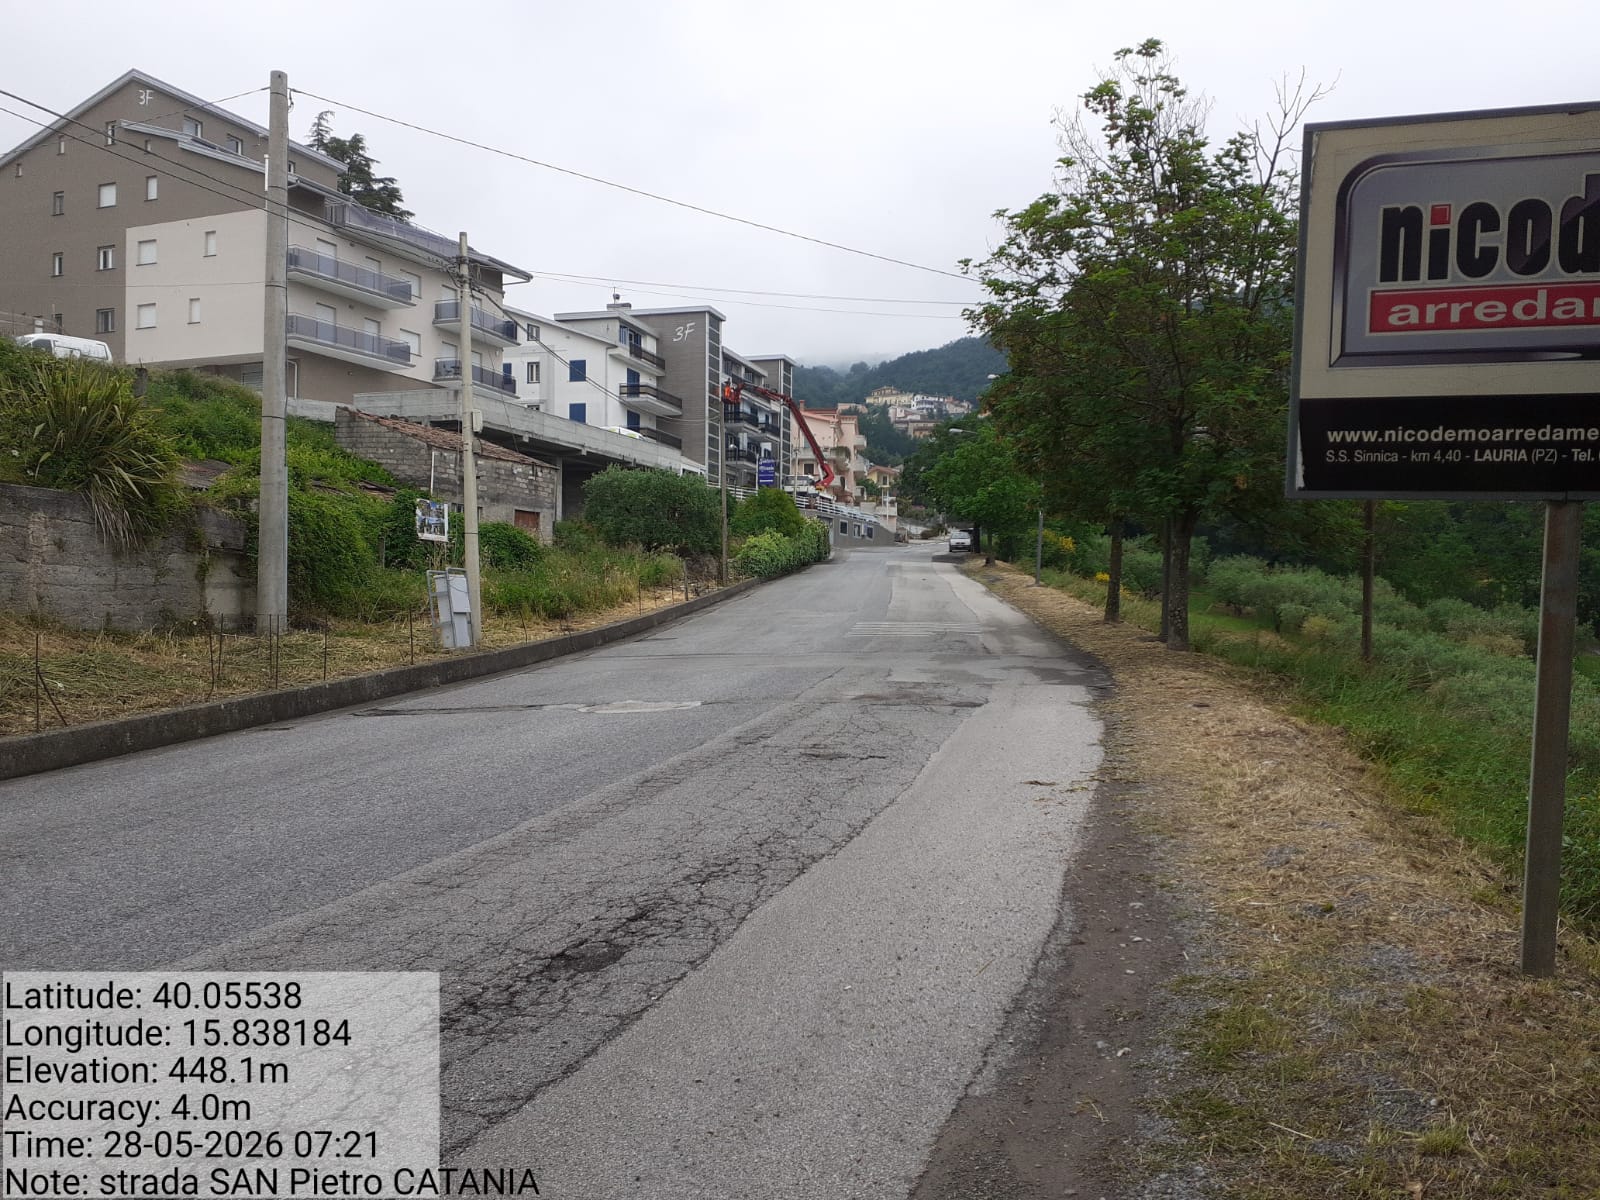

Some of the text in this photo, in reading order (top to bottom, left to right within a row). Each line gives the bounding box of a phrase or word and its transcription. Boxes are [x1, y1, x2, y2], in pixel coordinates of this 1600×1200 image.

[138, 89, 154, 105] 3F
[672, 322, 696, 342] 3F
[1327, 424, 1600, 442] www.nicodemoarredame
[1326, 449, 1350, 462] S.S.
[1354, 449, 1399, 462] Sinnica
[1411, 449, 1430, 462] km
[1433, 449, 1461, 464] 4,40
[1474, 449, 1528, 462] LAURIA
[1531, 448, 1558, 464] (PZ)
[1571, 448, 1595, 462] Tel.
